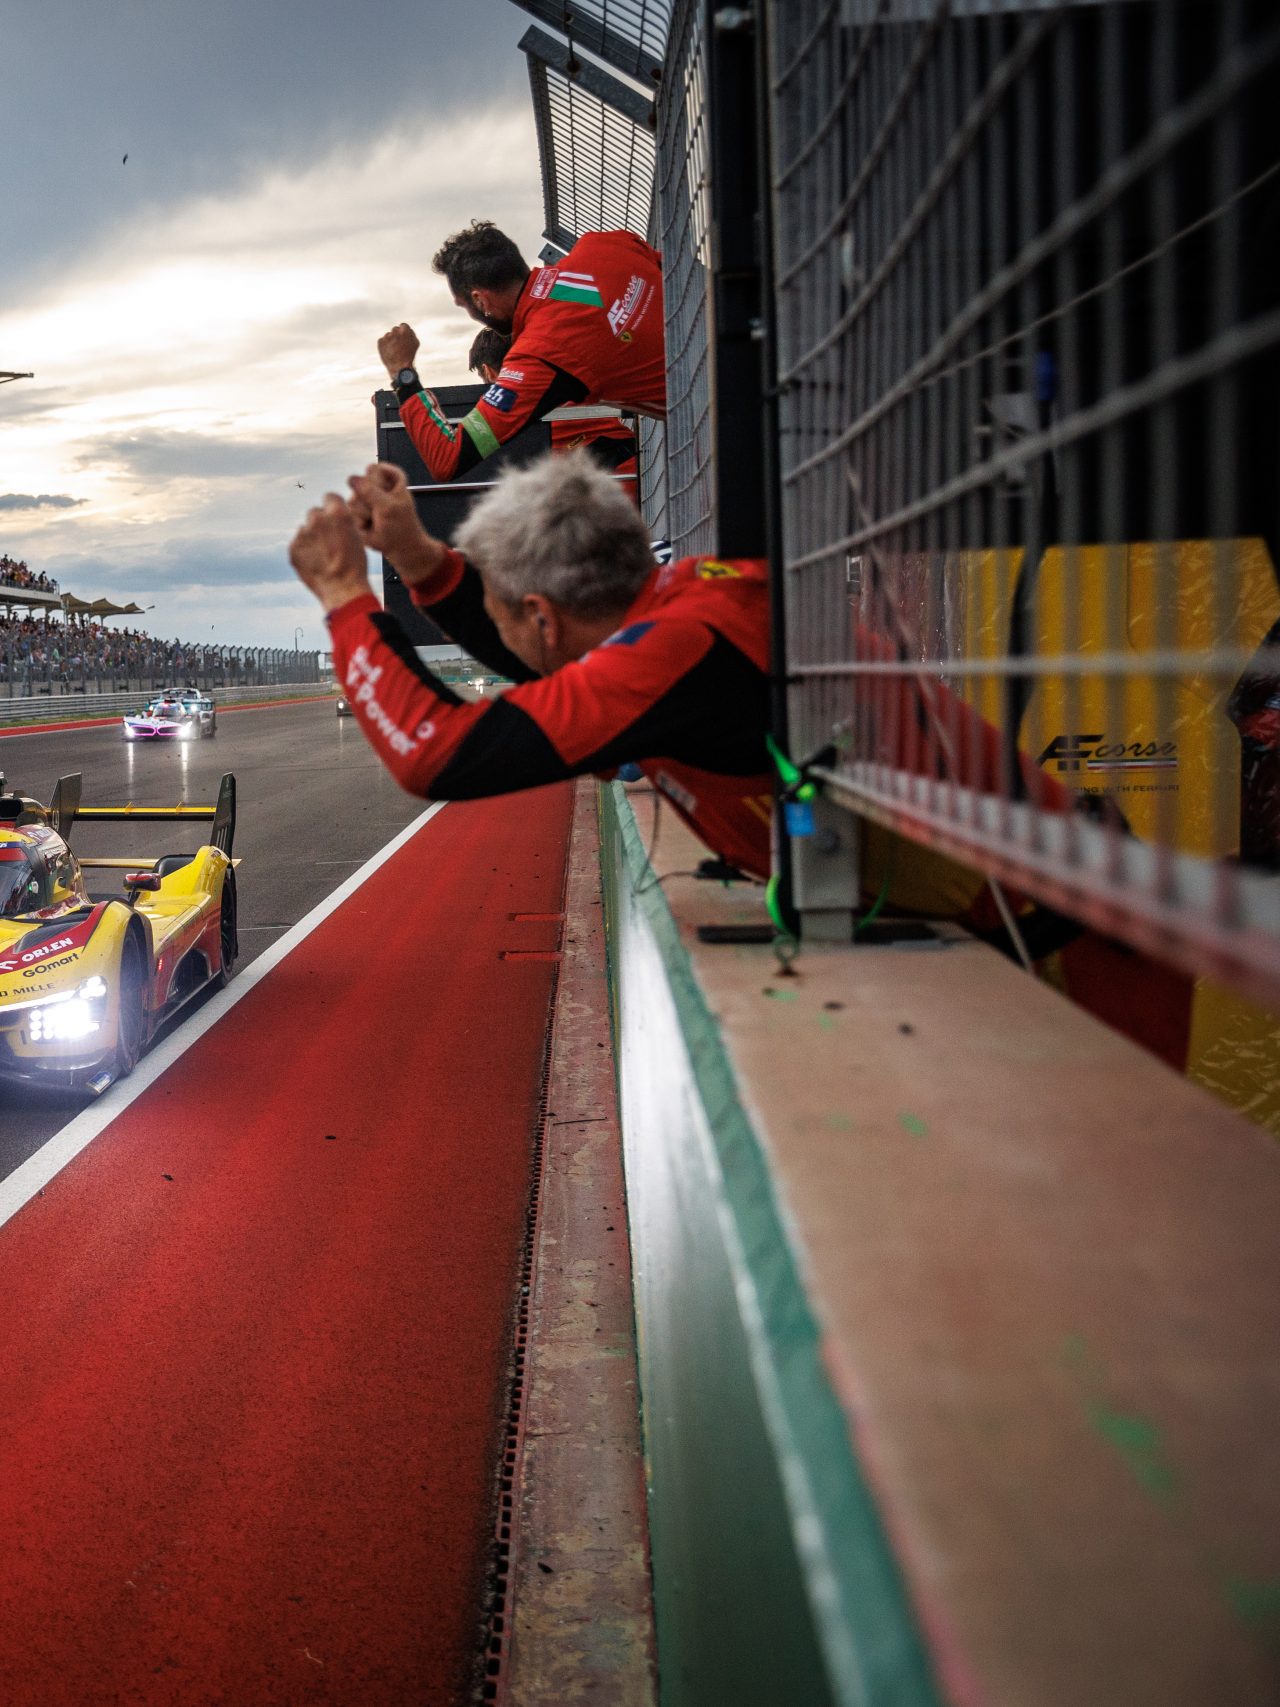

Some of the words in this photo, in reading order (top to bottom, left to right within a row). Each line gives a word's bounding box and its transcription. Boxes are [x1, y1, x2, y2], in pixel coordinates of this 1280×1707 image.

[21, 938, 73, 962] ORLEN
[22, 952, 80, 978] GOmart
[12, 982, 57, 996] MILLE
